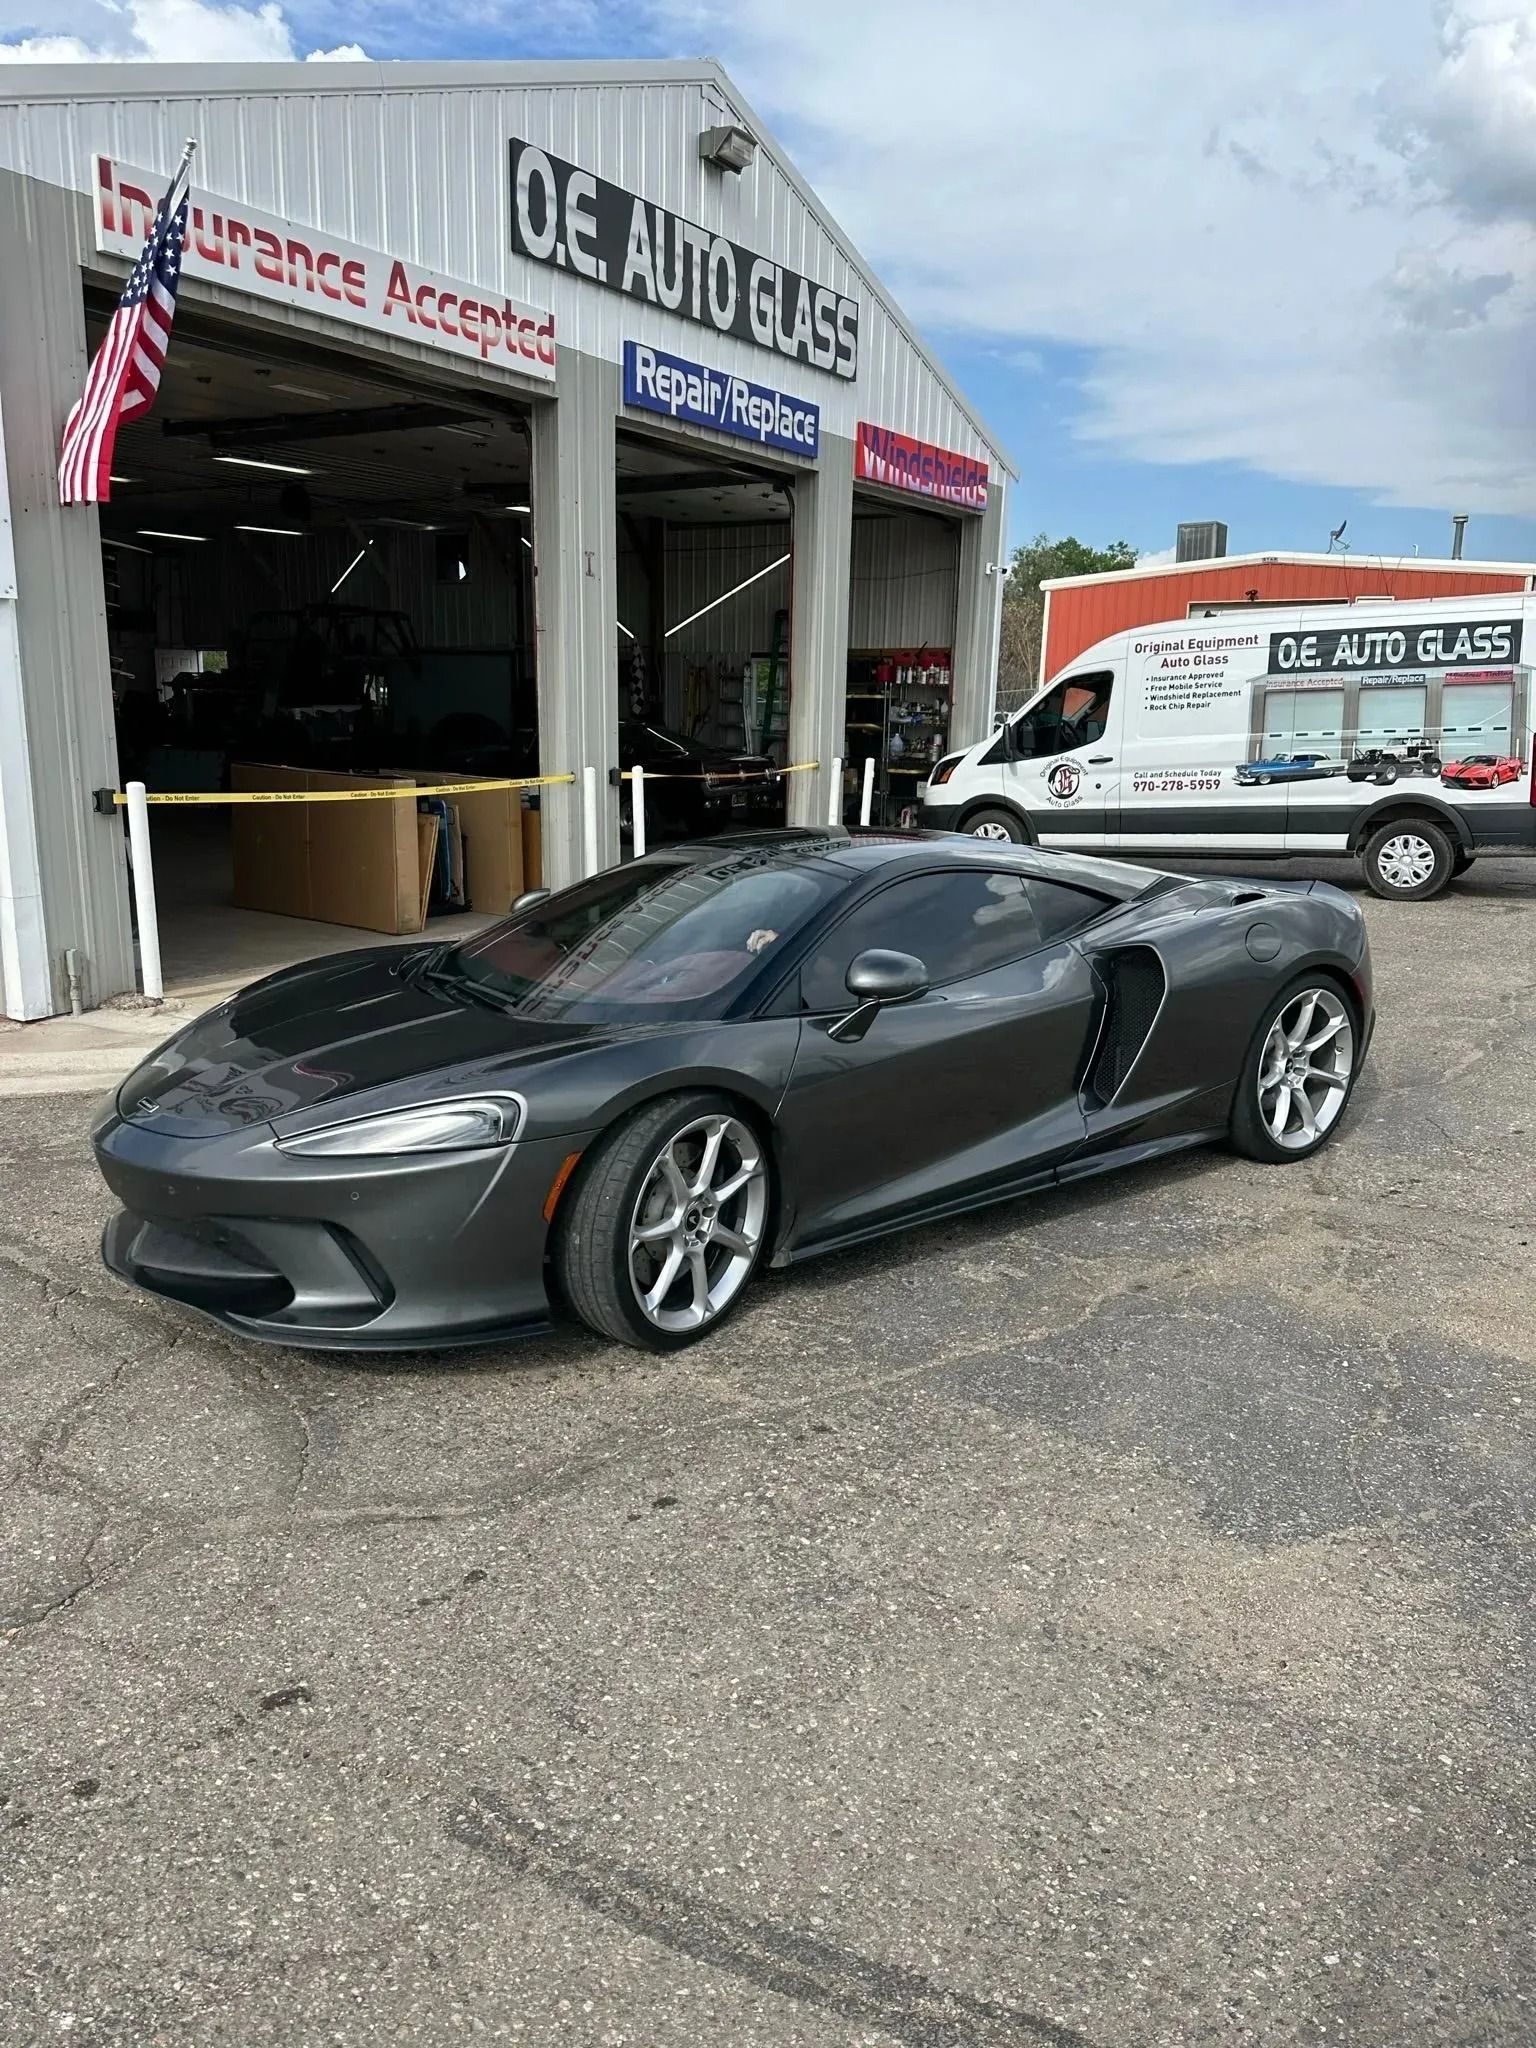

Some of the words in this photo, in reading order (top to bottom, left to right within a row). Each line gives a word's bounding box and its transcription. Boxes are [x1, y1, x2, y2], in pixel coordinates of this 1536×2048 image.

[98, 157, 367, 309] Inurance
[382, 260, 555, 366] Accepted
[516, 146, 607, 282] O.E.
[622, 198, 737, 330] AUTO
[749, 257, 858, 379] GLASS
[636, 344, 815, 447] Repair/Replace
[862, 422, 988, 509] Windshields
[1134, 639, 1184, 655] Original
[1188, 634, 1259, 651] Equipment
[1278, 636, 1322, 669] O.E.
[1332, 631, 1406, 666] AUTO
[1417, 625, 1512, 662] GLASS
[1161, 658, 1190, 668] Auto
[1193, 655, 1229, 666] Glass
[1151, 674, 1187, 683] Insurance
[1188, 671, 1224, 681] Approved
[1362, 675, 1424, 686] Repair/Replace
[1150, 684, 1167, 692] Free
[1168, 682, 1193, 691] Mobile
[1194, 681, 1223, 690] Service
[1150, 692, 1190, 701] Windshield
[1192, 690, 1242, 700] Replacement
[1168, 702, 1185, 711] Chip
[1186, 701, 1211, 710] Repair
[1164, 770, 1199, 778] Schedule
[1200, 769, 1222, 777] Today
[1133, 779, 1221, 792] 970-278-5959
